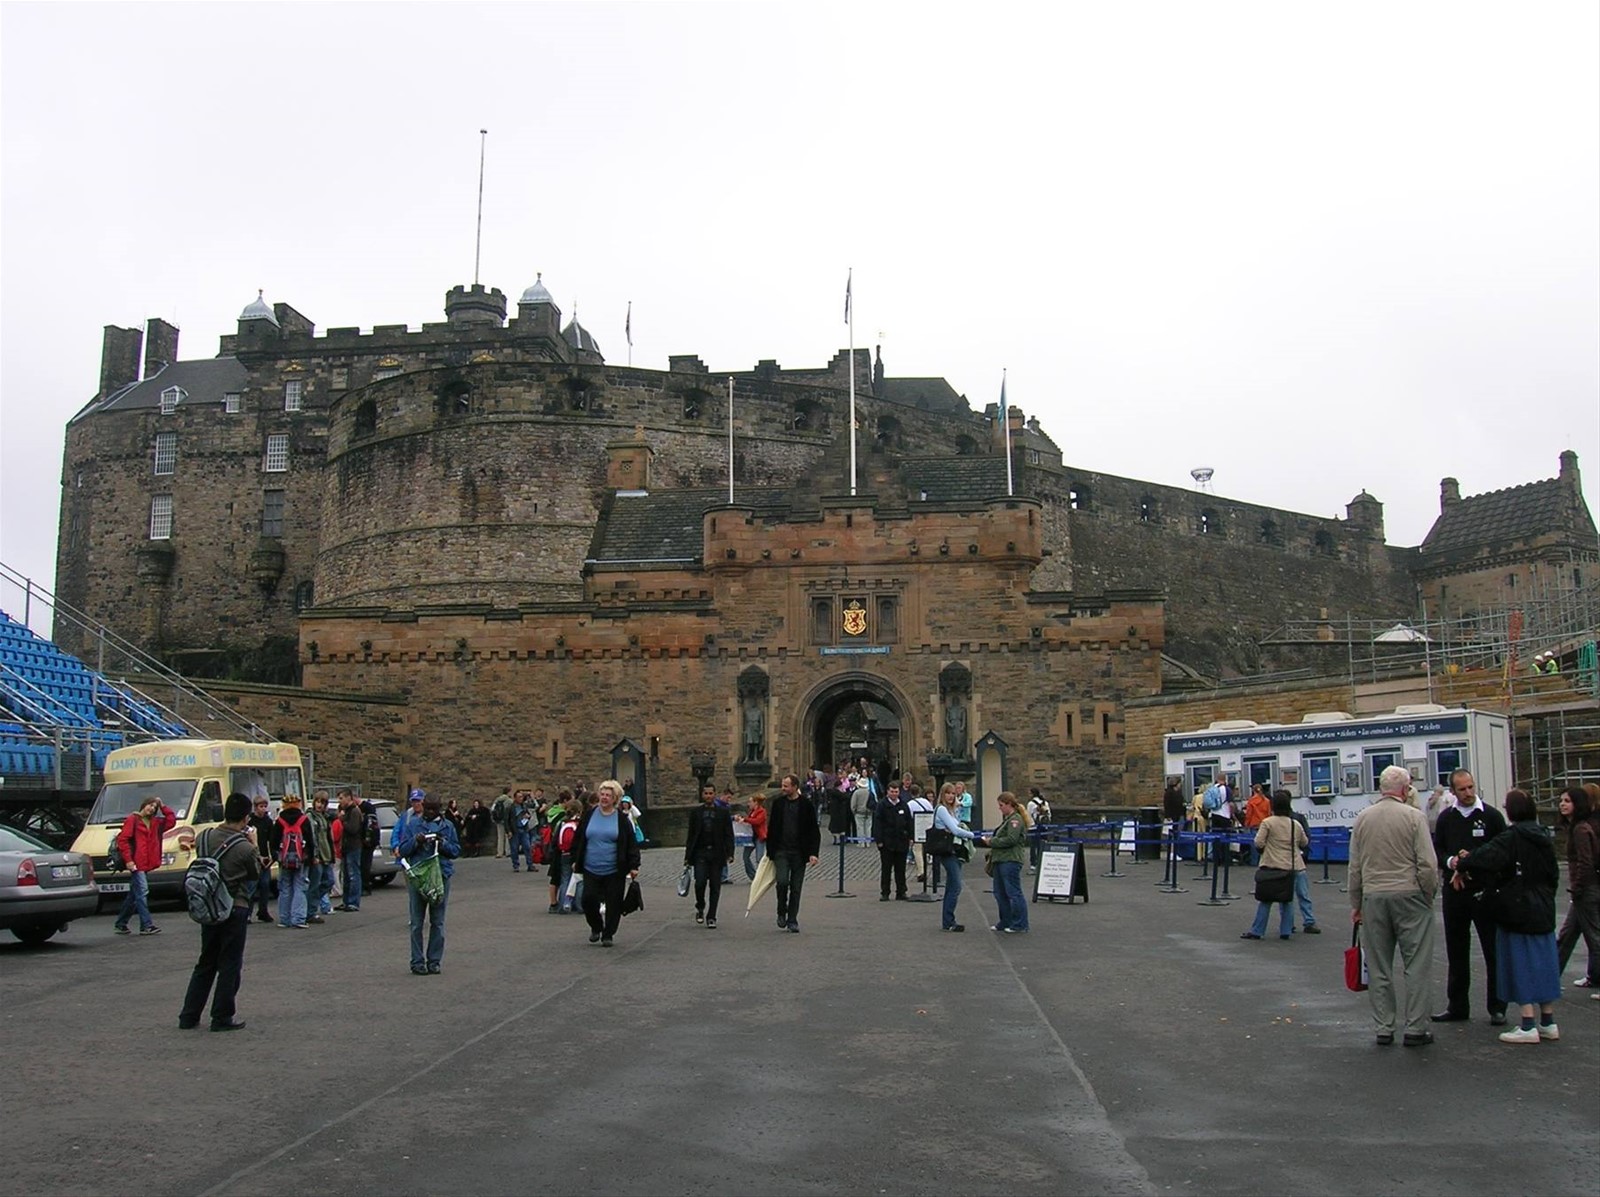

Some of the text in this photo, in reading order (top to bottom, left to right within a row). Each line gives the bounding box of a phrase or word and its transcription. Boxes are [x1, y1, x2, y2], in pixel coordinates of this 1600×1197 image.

[1316, 731, 1336, 739] Karten
[1423, 722, 1441, 731] tickets
[248, 748, 257, 760] ICE
[110, 754, 196, 770] DAIRY ICE CREAM
[1340, 808, 1363, 819] Cas
